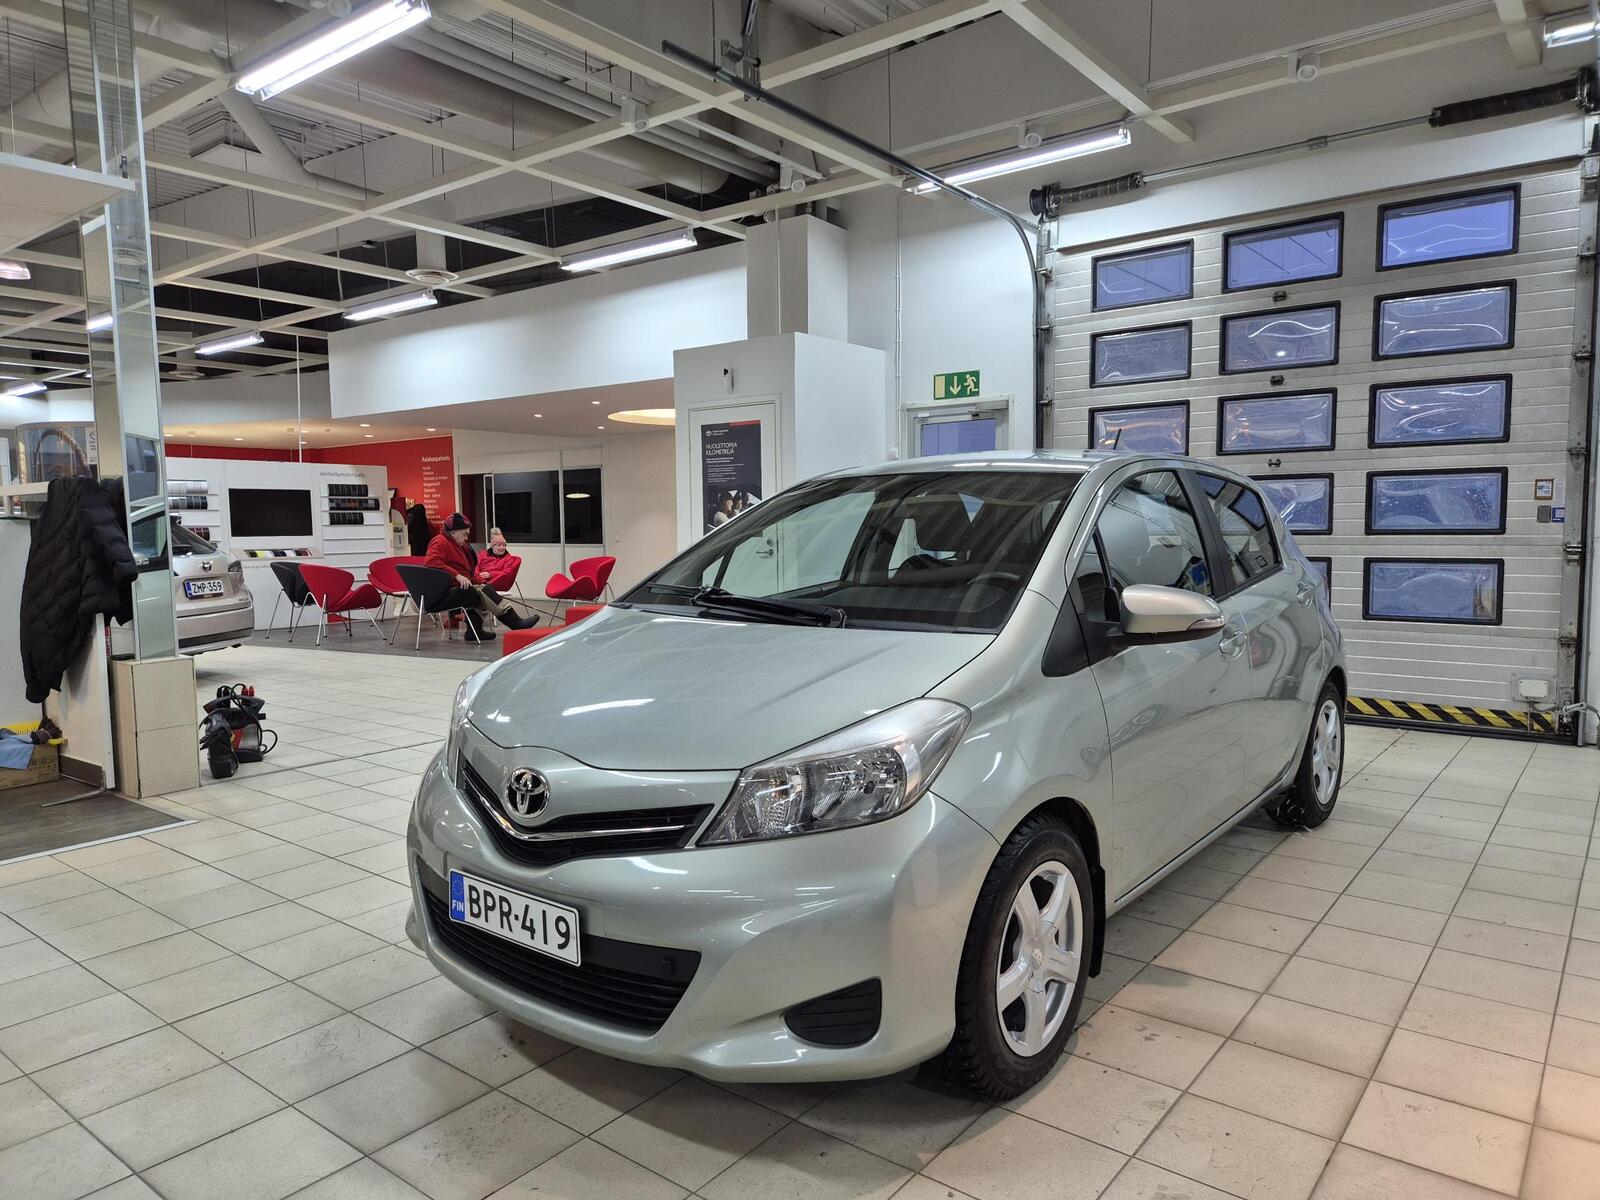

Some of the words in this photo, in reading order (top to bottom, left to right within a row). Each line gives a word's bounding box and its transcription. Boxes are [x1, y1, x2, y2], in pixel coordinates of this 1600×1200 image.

[192, 581, 222, 593] ZMP-359
[452, 900, 464, 912] FIN
[468, 884, 571, 950] BPR-419
